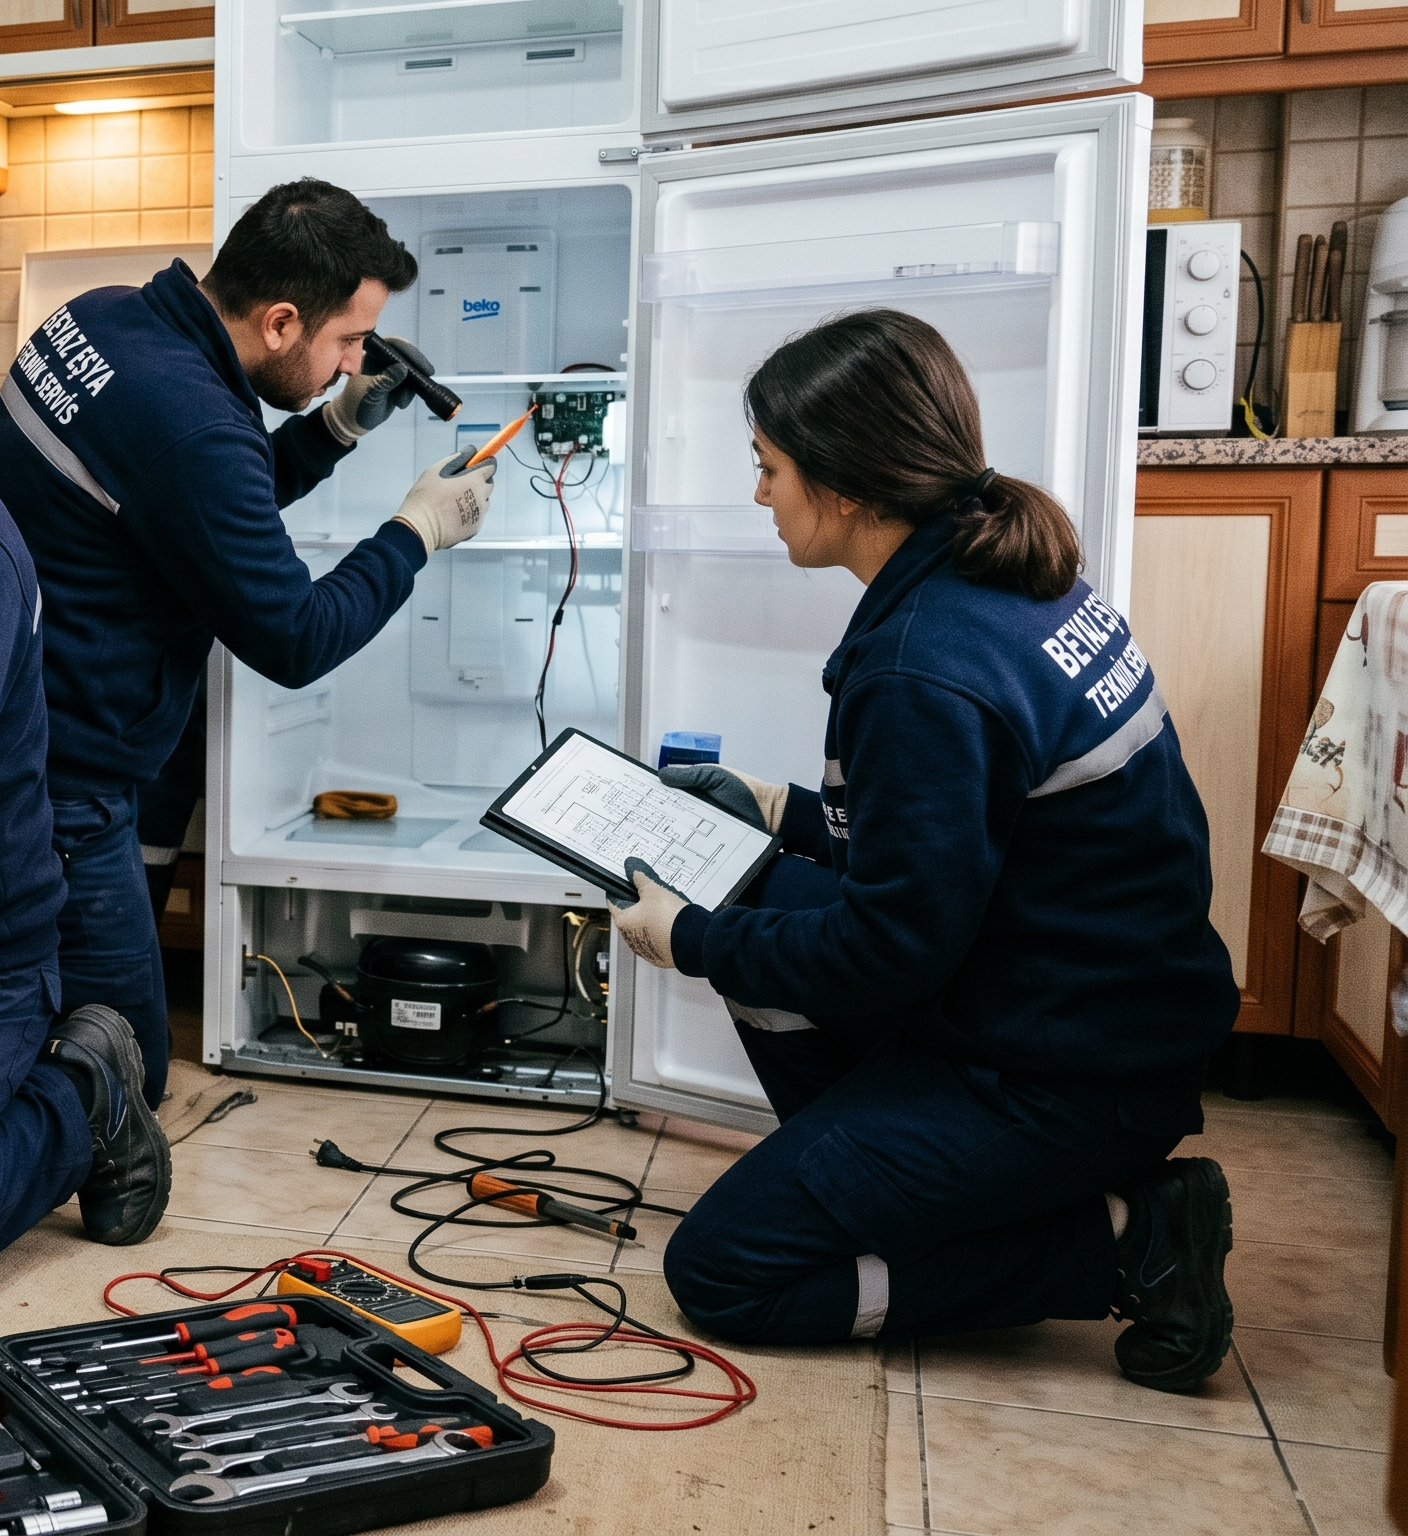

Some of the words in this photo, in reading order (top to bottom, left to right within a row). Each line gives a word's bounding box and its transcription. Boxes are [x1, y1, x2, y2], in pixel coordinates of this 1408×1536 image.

[463, 299, 500, 312] beko
[42, 305, 88, 359] BEYAZ
[65, 345, 115, 397] EŞYA
[34, 372, 79, 425] SERVİS
[1041, 607, 1110, 679] BEYAZ
[1085, 655, 1140, 718] TEKNİK
